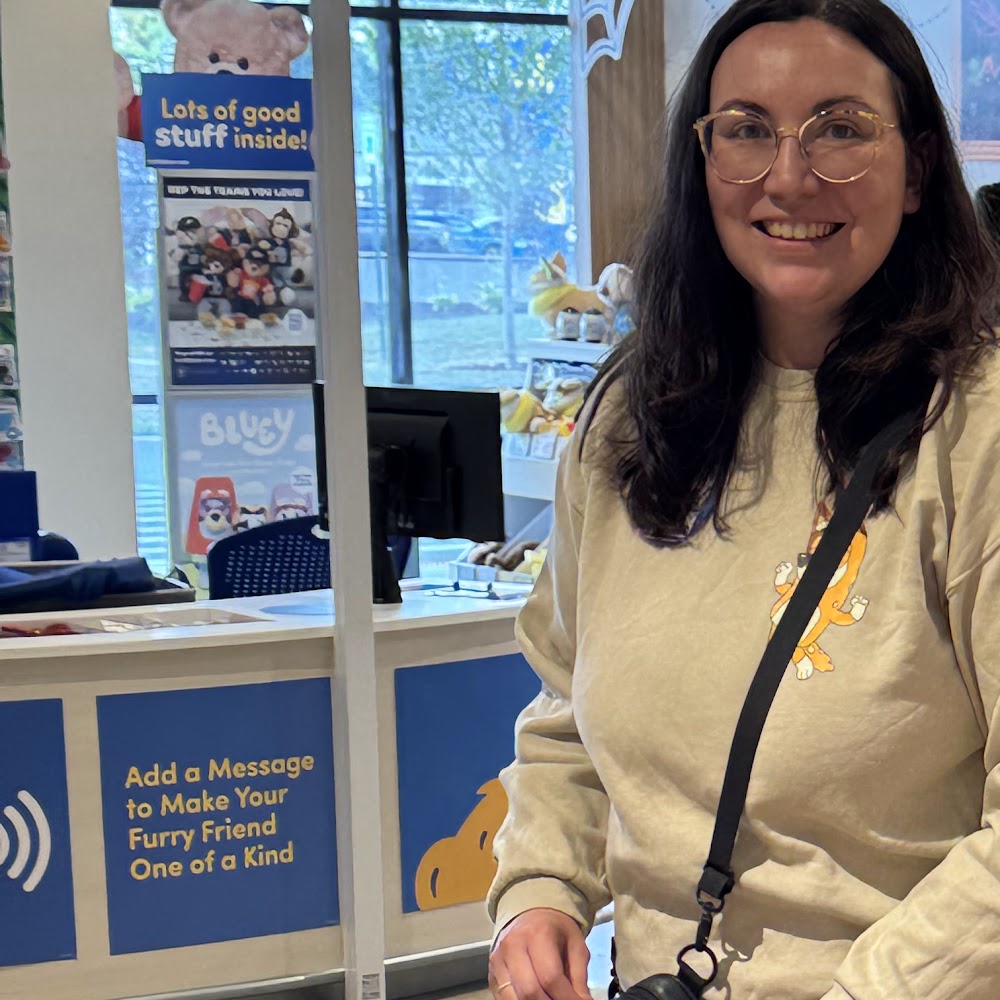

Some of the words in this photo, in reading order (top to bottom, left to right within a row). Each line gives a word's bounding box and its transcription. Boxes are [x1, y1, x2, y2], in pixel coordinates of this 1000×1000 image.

[161, 97, 208, 120] Lots
[213, 98, 238, 120] of
[242, 100, 301, 127] good
[155, 122, 228, 148] stuff
[233, 126, 307, 150] inside!
[125, 761, 177, 789] Add
[184, 767, 200, 783] a
[208, 755, 315, 779] Message
[126, 799, 153, 819] to
[160, 790, 230, 816] Make
[234, 786, 288, 808] Your
[129, 827, 195, 851] Furry
[202, 812, 277, 843] Friend
[130, 858, 183, 880] One
[189, 850, 215, 875] of
[221, 854, 236, 871] a
[244, 840, 294, 868] Kind
